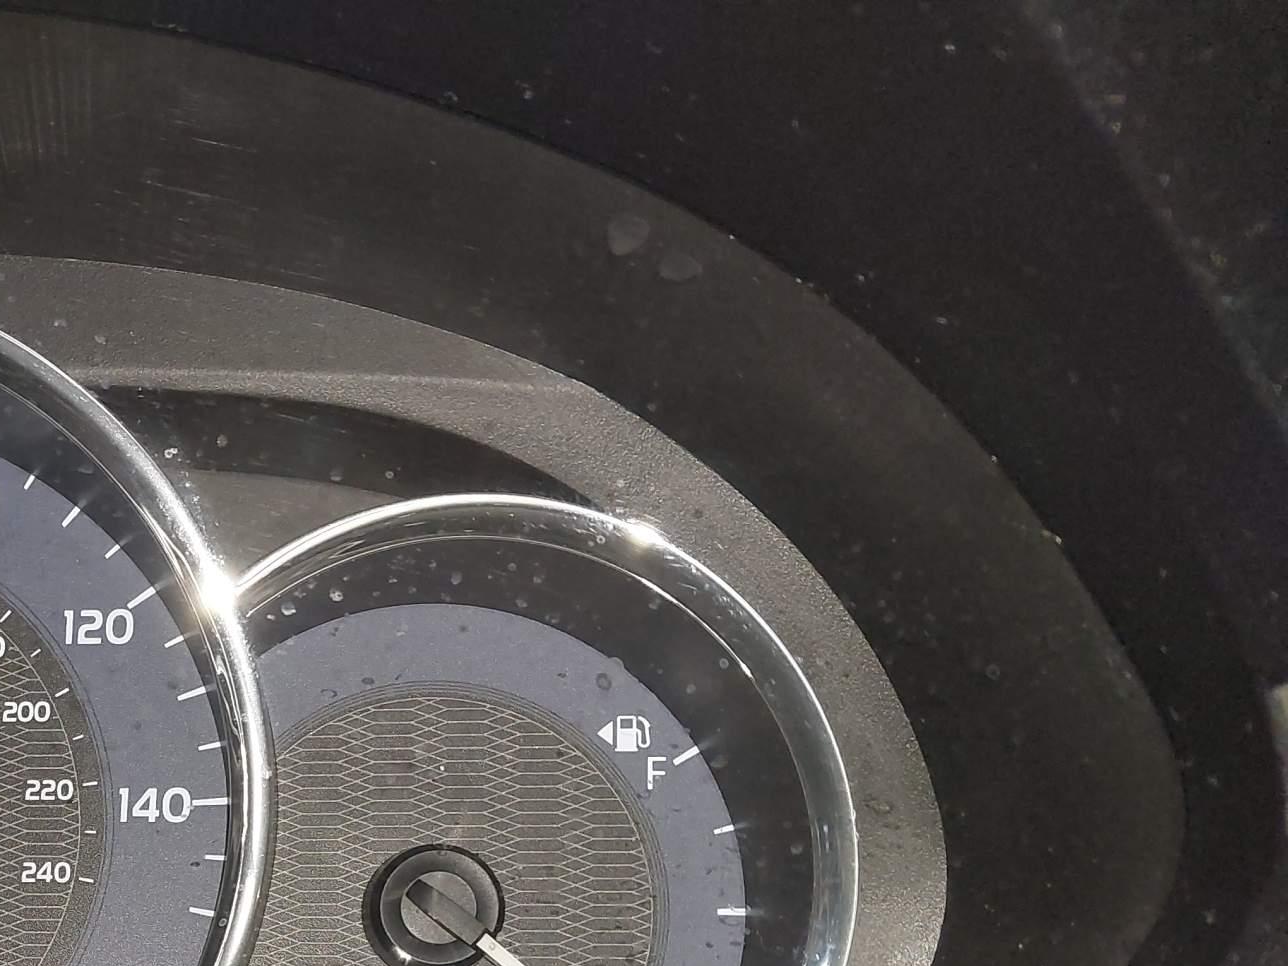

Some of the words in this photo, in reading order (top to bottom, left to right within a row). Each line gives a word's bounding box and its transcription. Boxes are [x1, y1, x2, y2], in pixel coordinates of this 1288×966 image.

[64, 605, 135, 645] 120
[2, 700, 51, 723] 200
[647, 756, 667, 790] F
[24, 779, 74, 801] 220
[119, 787, 192, 823] 140
[21, 861, 71, 883] 240
